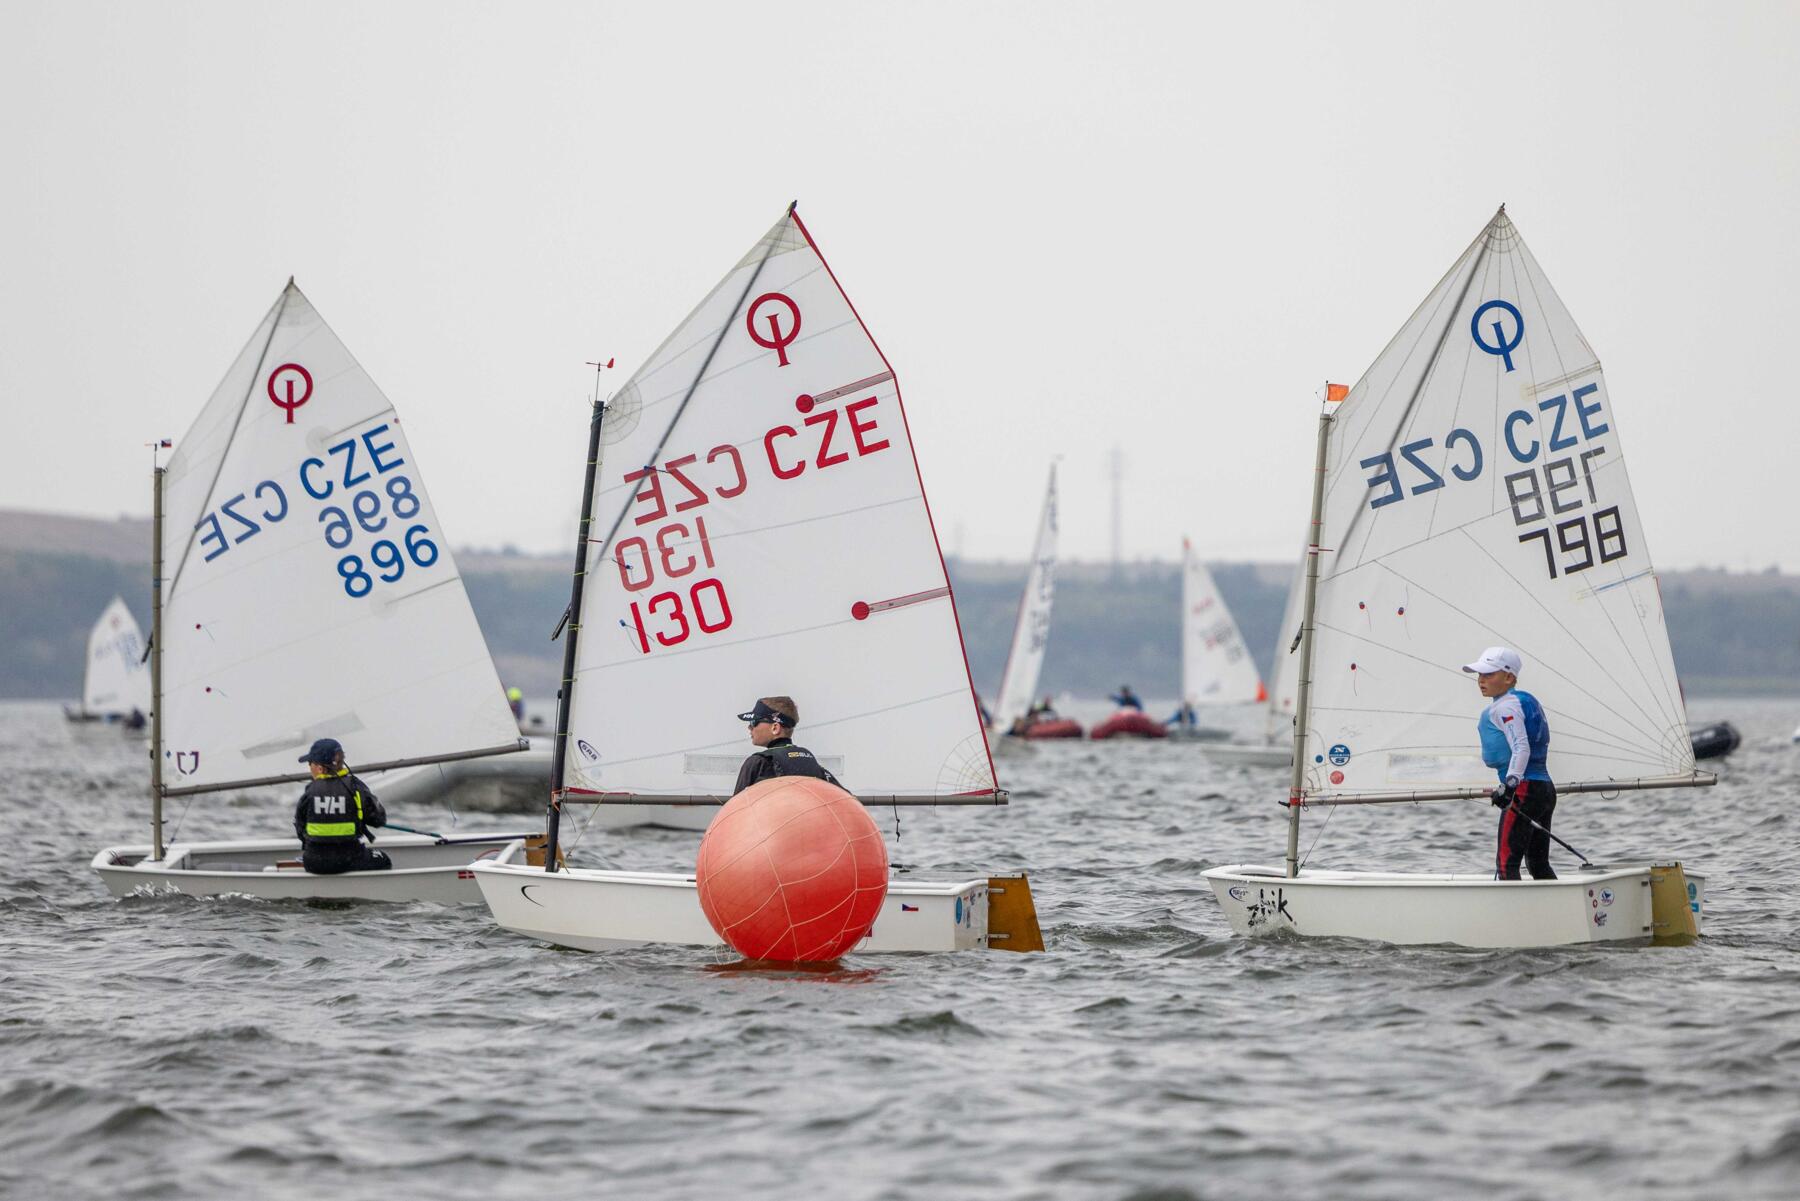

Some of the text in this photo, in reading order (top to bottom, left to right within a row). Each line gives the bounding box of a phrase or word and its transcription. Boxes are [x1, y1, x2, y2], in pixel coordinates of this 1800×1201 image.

[764, 396, 890, 480] CZE
[1505, 383, 1610, 463] CZE
[299, 424, 405, 501] CZE
[337, 524, 439, 599] 896
[1518, 505, 1628, 580] 798
[629, 577, 734, 655] 130
[314, 796, 346, 814] HH
